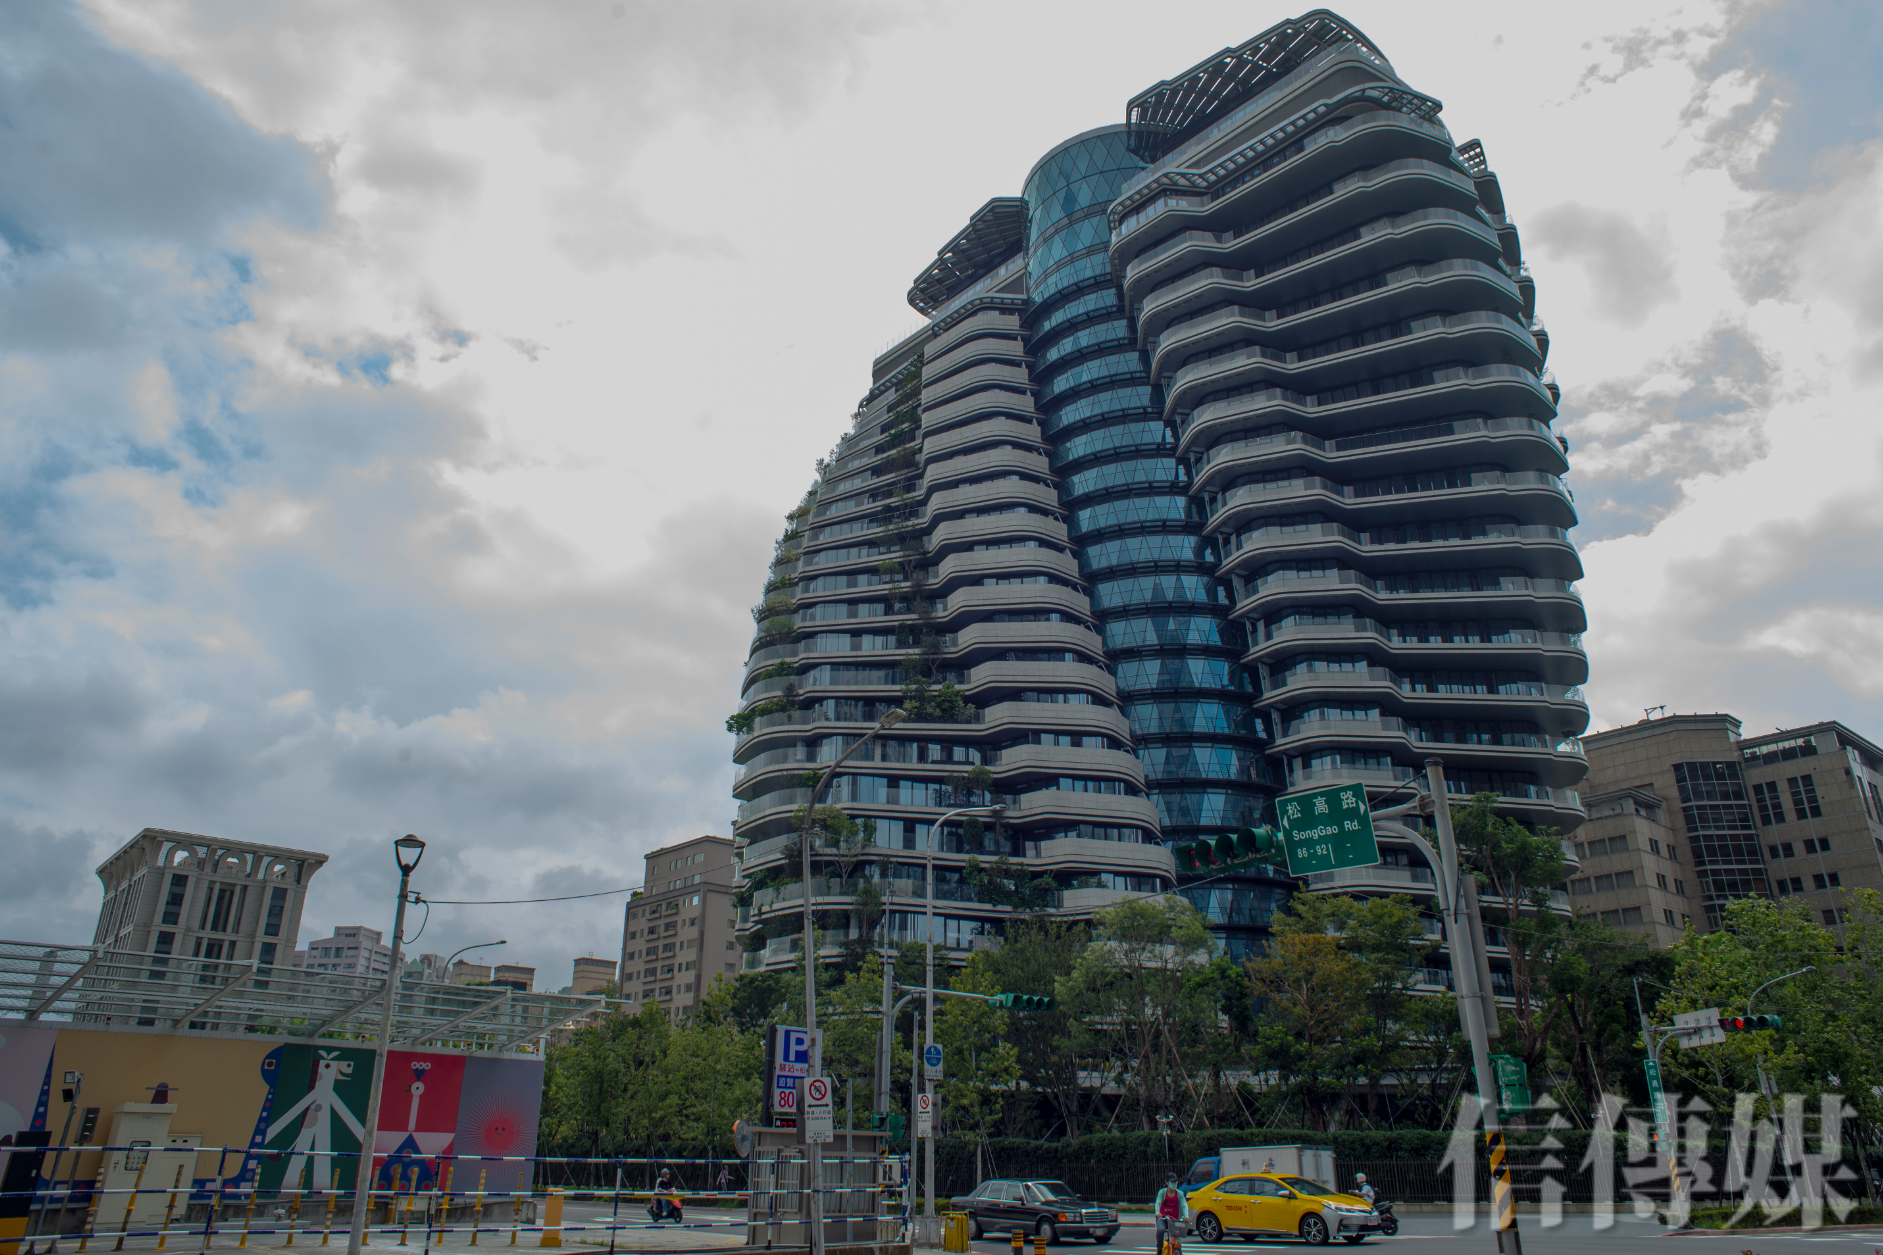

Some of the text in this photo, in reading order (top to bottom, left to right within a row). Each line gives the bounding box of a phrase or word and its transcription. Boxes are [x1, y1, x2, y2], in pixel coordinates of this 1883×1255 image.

[1286, 790, 1357, 820] 松高路
[1292, 819, 1362, 841] SongGao Rd.
[788, 1031, 809, 1062] P
[778, 1090, 795, 1108] 80
